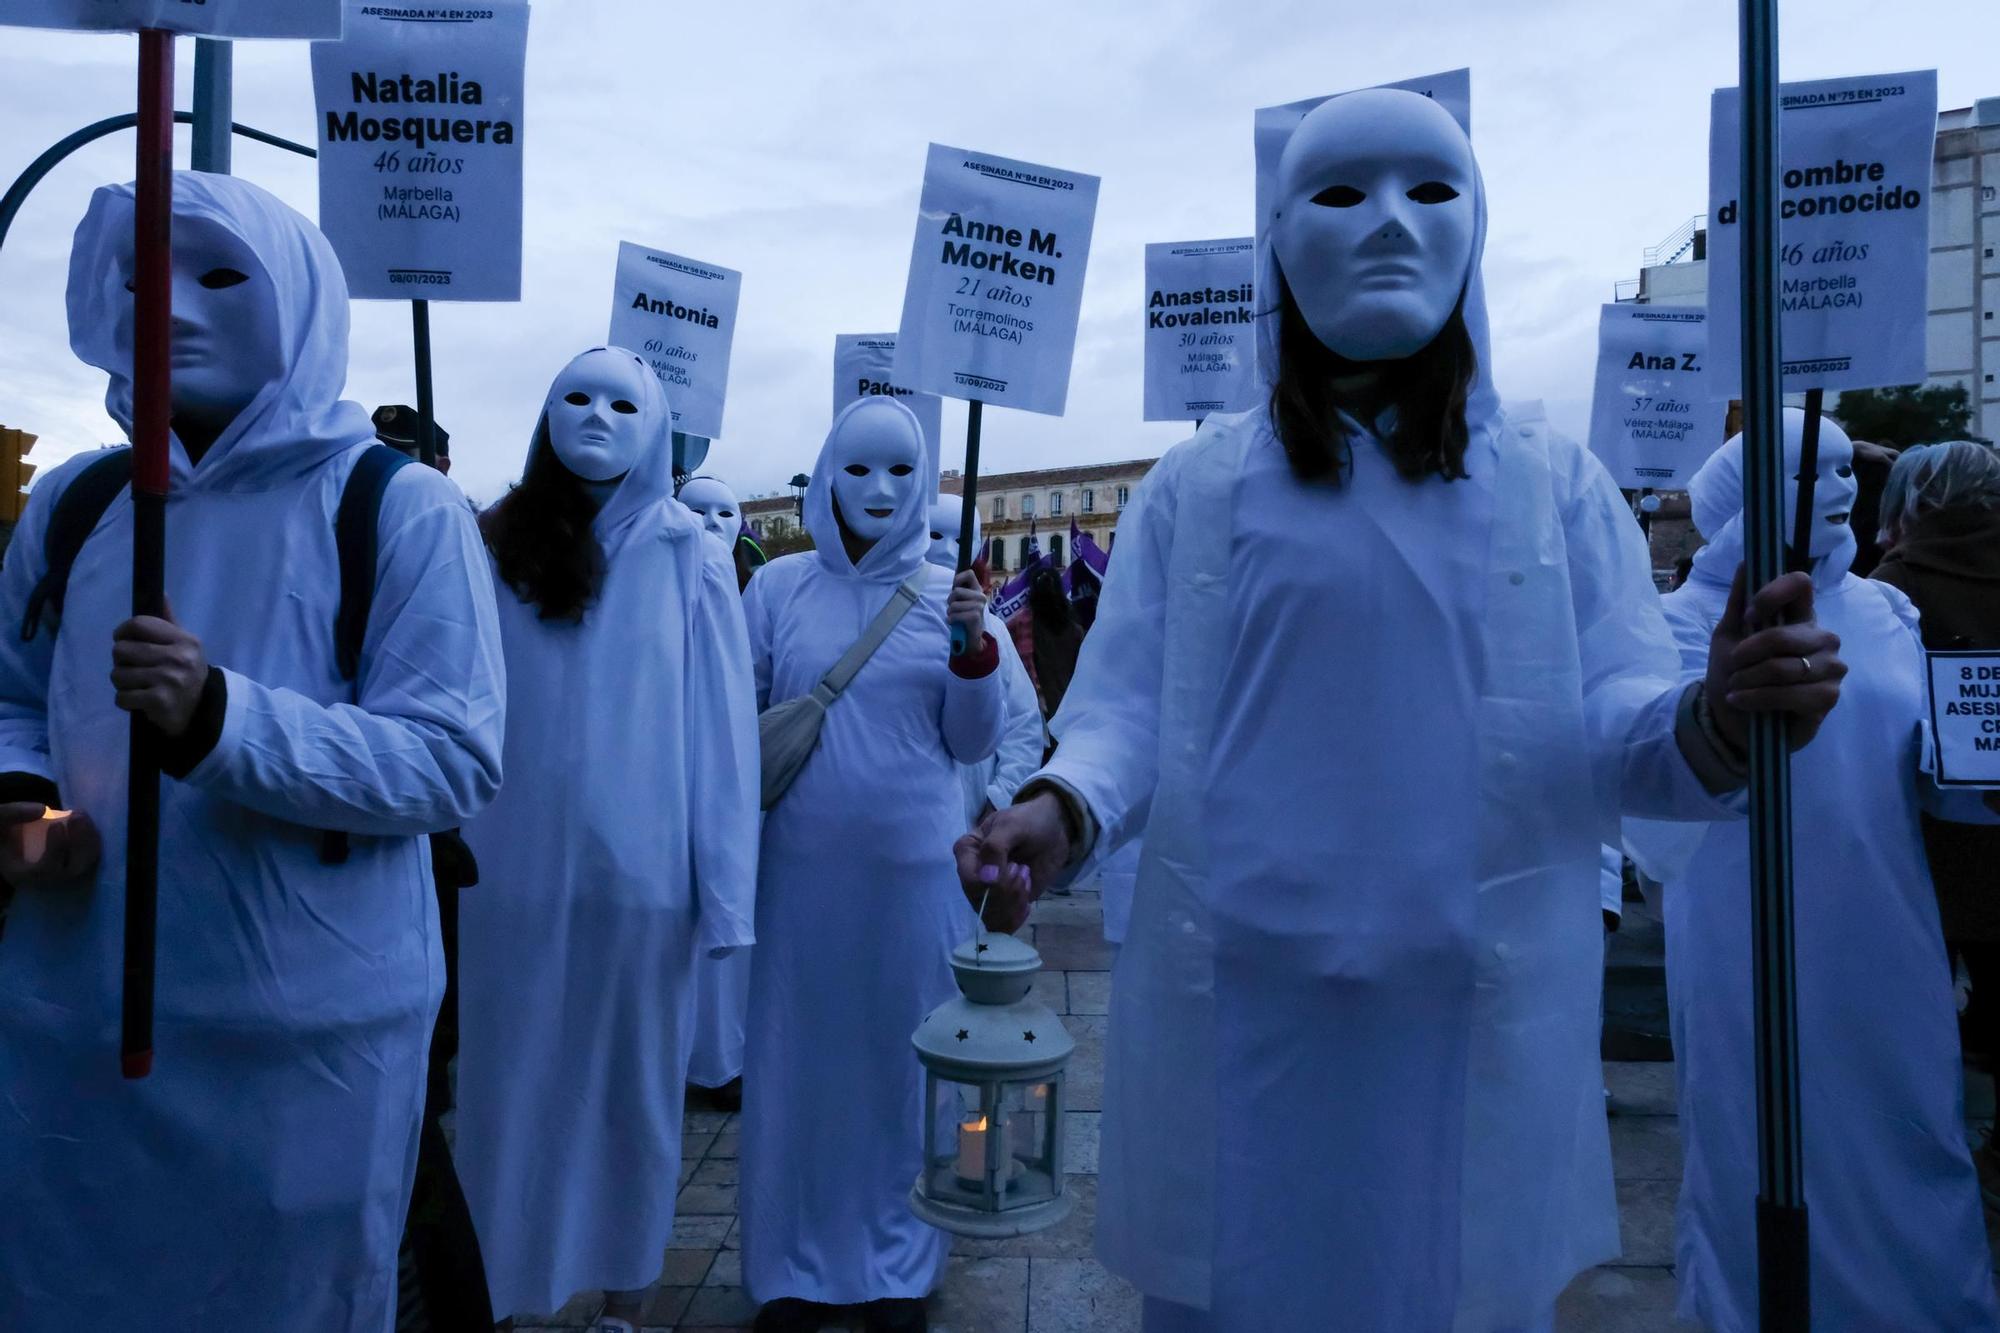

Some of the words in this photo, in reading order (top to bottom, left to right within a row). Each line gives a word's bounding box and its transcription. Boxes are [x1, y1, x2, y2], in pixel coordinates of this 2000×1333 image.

[361, 6, 425, 18] ASESINADA
[449, 10, 464, 18] EN
[465, 10, 493, 19] 2023
[351, 71, 482, 105] Natalia
[1858, 89, 1872, 99] EN
[1875, 86, 1905, 98] 2023
[326, 111, 513, 149] Mosquera
[373, 150, 399, 173] 46
[407, 151, 464, 174] años
[963, 161, 1013, 178] ASESINADA
[1039, 177, 1051, 186] EN
[1051, 179, 1074, 190] 2023
[1781, 160, 1885, 189] ombre
[384, 186, 453, 202] Marbella
[1718, 185, 1921, 225] dconocido
[378, 201, 460, 223] (MÁLAGA)
[941, 212, 1022, 248] Anne
[1028, 228, 1062, 258] M.
[941, 241, 1055, 285] Morken
[1812, 240, 1869, 264] años
[955, 276, 981, 297] 21
[986, 285, 1032, 308] años
[1149, 284, 1252, 308] Anastasii
[1783, 275, 1856, 294] Marbella
[632, 292, 719, 329] Antonia
[1781, 291, 1862, 312] MÁLAGA)
[948, 302, 1034, 331] Torremolinos
[954, 319, 1023, 344] (MÁLAGA)
[1178, 332, 1196, 347] 30
[1200, 332, 1234, 345] años
[644, 339, 663, 353] 60
[665, 346, 698, 362] años
[1627, 351, 1676, 371] Ana
[1681, 353, 1701, 372] Z.
[1783, 361, 1850, 376] 28/05/2023
[955, 375, 1006, 392] 13/09/2023
[1632, 398, 1653, 412] 57
[1656, 399, 1691, 413] años
[1960, 666, 1973, 681] 8
[1959, 684, 2000, 698] MUJ
